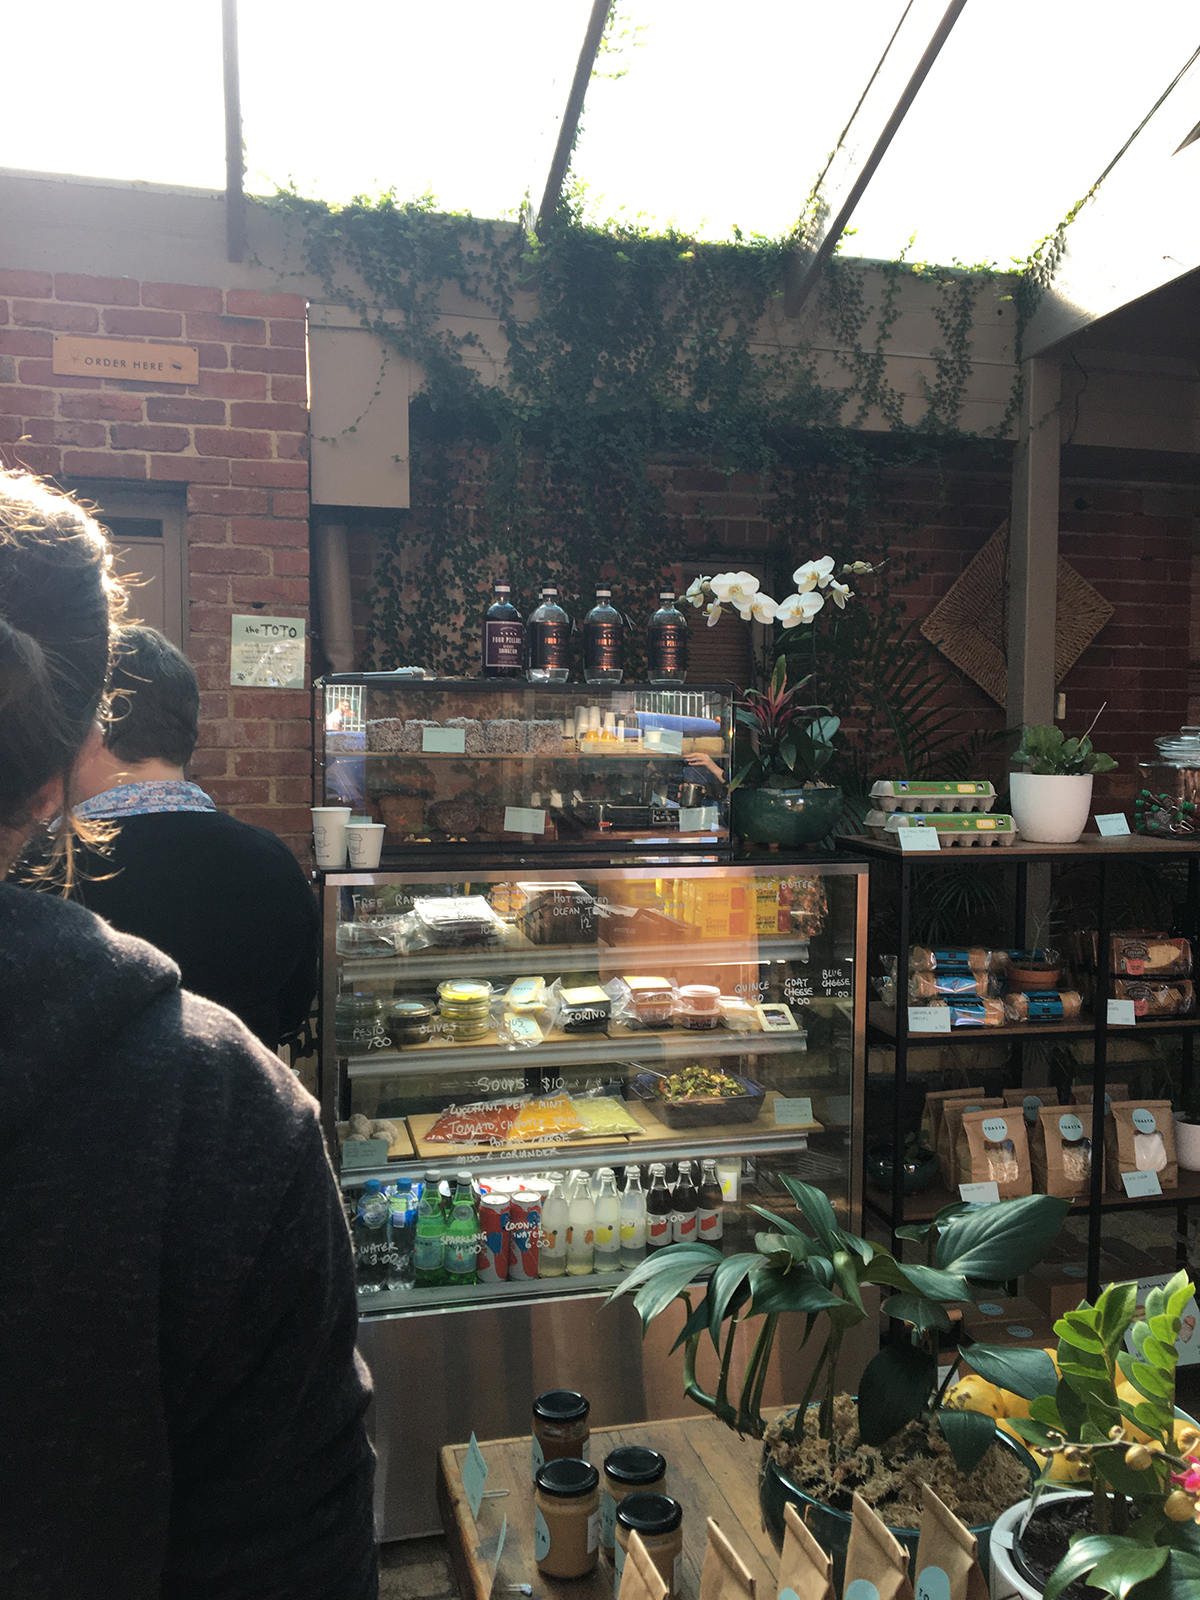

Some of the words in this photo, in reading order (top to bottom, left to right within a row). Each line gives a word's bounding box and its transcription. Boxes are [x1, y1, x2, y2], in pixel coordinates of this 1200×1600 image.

[84, 356, 127, 368] ORDER
[133, 360, 164, 371] HERE
[261, 624, 297, 639] TOTO
[781, 880, 814, 890] BUTTER
[352, 894, 386, 910] FREE
[553, 890, 571, 903] HOT
[553, 906, 580, 916] OCEAN
[822, 969, 843, 979] BLUE
[734, 981, 770, 993] QUINCE
[784, 978, 809, 988] GOAT
[821, 978, 851, 988] CHEESE
[783, 988, 814, 997] CHEESE
[420, 1022, 457, 1034] OLIVES
[541, 1077, 565, 1093] $10
[505, 1100, 526, 1110] PEA
[538, 1099, 566, 1109] MINT
[457, 1155, 480, 1164] MISO
[500, 1147, 560, 1159] CORIANDER
[513, 1231, 546, 1239] WATER
[361, 1242, 399, 1254] WATER
